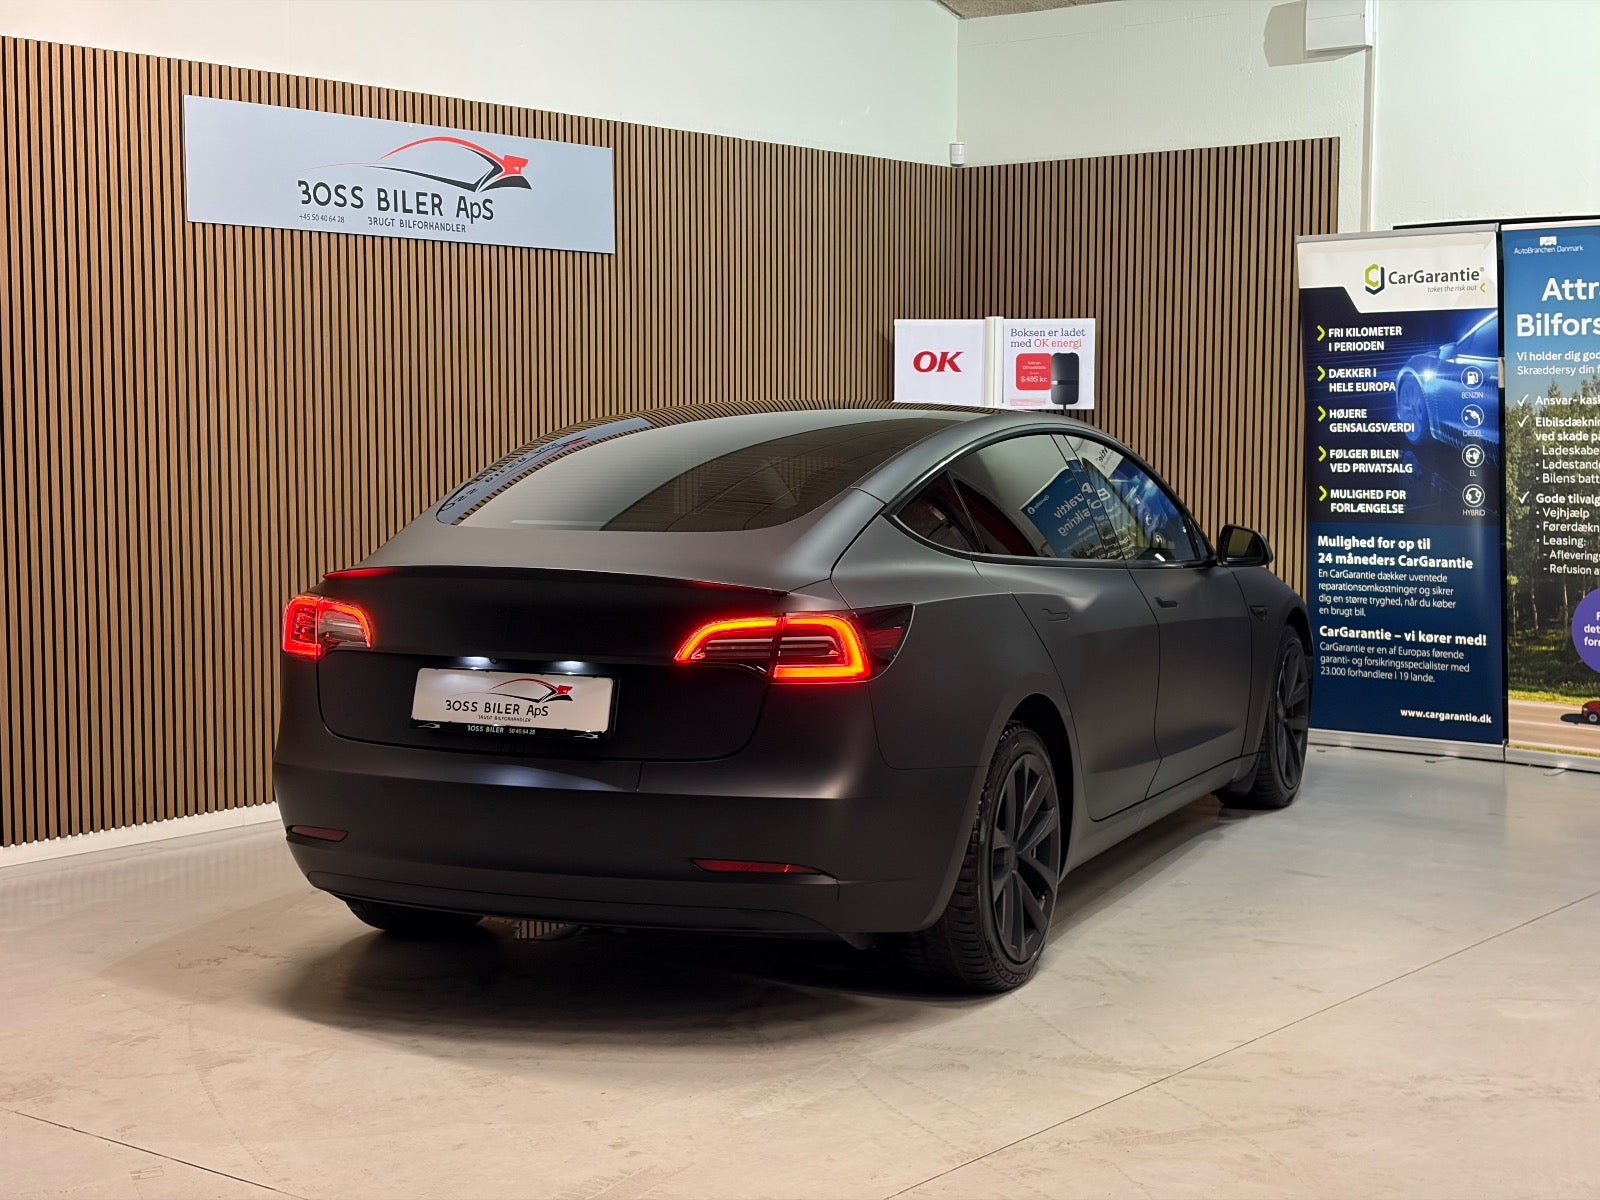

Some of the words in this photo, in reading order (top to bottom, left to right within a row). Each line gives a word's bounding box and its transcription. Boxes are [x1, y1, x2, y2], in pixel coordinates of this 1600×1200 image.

[377, 188, 443, 216] BILER
[456, 196, 494, 224] ApS
[400, 220, 466, 232] BILFORHANDLER
[1514, 247, 1555, 255] AutoBranchen
[1557, 245, 1584, 253] Danmark
[1542, 278, 1600, 302] Attr
[1010, 328, 1045, 337] Boksen
[1061, 328, 1086, 336] ladet
[1328, 328, 1343, 338] FRI
[1346, 326, 1402, 338] KILOMETER
[1010, 339, 1032, 348] med
[1034, 339, 1049, 348] OK
[1052, 339, 1082, 349] energi
[1334, 341, 1384, 352] PERIODEN
[913, 351, 964, 373] OK
[1517, 352, 1526, 362] Vi
[1530, 352, 1563, 361] holder
[1565, 351, 1581, 362] dig
[1329, 369, 1371, 379] DÆKKER
[1517, 365, 1576, 376] Skræddersy
[1579, 365, 1594, 374] din
[1329, 383, 1354, 392] HELE
[1356, 382, 1396, 392] EUROPA
[1535, 396, 1577, 405] Ansvar-
[1330, 409, 1367, 419] HØJERE
[1330, 423, 1414, 433] GENSALGSVÆRDI
[1536, 431, 1555, 441] ved
[1558, 431, 1589, 441] skade
[1330, 449, 1368, 459] FØLGER
[1371, 450, 1398, 459] BILEN
[1330, 463, 1350, 473] VED
[1353, 463, 1413, 474] PRIVATSALG
[1543, 459, 1600, 470] Ladestand
[1543, 473, 1576, 484] Bilens
[1331, 489, 1383, 499] MULIGHED
[1386, 490, 1406, 500] FOR
[1536, 493, 1565, 504] Gode
[1331, 503, 1404, 514] FORLÆNGELSE
[1463, 509, 1485, 517] HYBRID
[1543, 507, 1590, 520] Vejhjælp
[1318, 536, 1374, 550] Mulighed
[1378, 537, 1396, 549] for
[1398, 540, 1414, 552] op
[1417, 538, 1430, 550] til
[1318, 553, 1333, 564] 24
[1336, 553, 1395, 566] måneders
[1398, 555, 1473, 569] CarGarantie
[1550, 550, 1600, 563] Aflevering
[1550, 564, 1592, 575] Refusion
[1319, 569, 1328, 578] En
[1330, 569, 1376, 580] CarGarantie
[1378, 571, 1407, 581] dækker
[1409, 573, 1448, 583] uventede
[1319, 582, 1417, 596] reparationsomkostninger
[1419, 587, 1430, 597] og
[1432, 586, 1454, 596] sikrer
[1319, 594, 1332, 604] dig
[1346, 596, 1367, 604] større
[1370, 596, 1403, 608] tryghed,
[1405, 597, 1418, 607] når
[1420, 599, 1431, 607] du
[1433, 598, 1456, 608] køber
[1319, 607, 1329, 615] en
[1331, 606, 1353, 618] brugt
[1355, 607, 1366, 617] bil.
[1320, 626, 1392, 640] CarGarantie
[1404, 630, 1416, 642] vi
[1419, 630, 1452, 644] kører
[1455, 634, 1487, 646] med!
[1320, 642, 1366, 653] CarGarantie
[1389, 646, 1397, 655] af
[1399, 646, 1430, 658] Europas
[1432, 648, 1464, 660] førende
[1320, 656, 1350, 664] garanti-
[1352, 658, 1362, 667] og
[1365, 656, 1449, 671] forsikringsspecialister
[1451, 664, 1470, 672] med
[1320, 666, 1346, 676] 23.000
[1348, 668, 1393, 679] forhandlere
[1400, 672, 1409, 680] 19
[1411, 672, 1435, 683] lande.
[484, 702, 520, 715] BILER
[526, 705, 549, 718] ApS
[1400, 709, 1492, 724] www.cargarantie.dk
[486, 726, 504, 734] BILER
